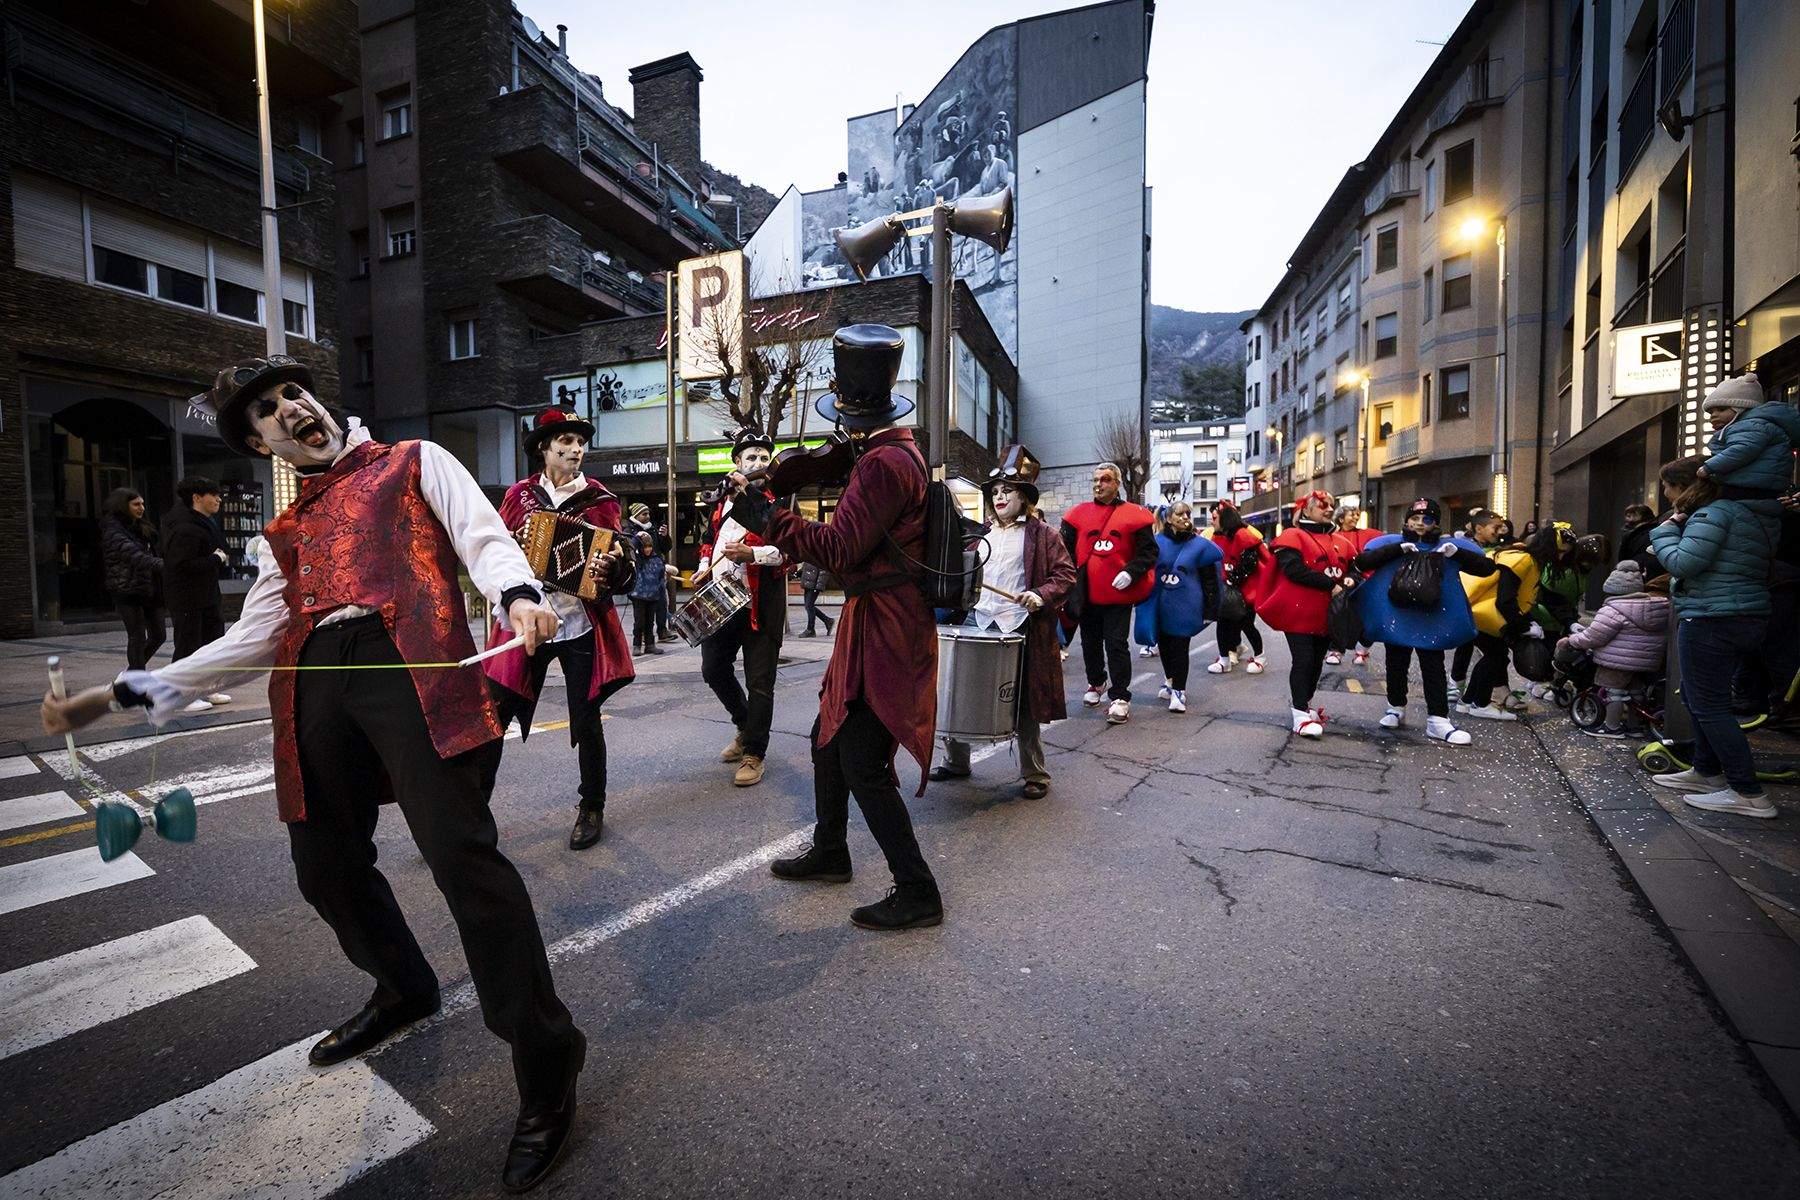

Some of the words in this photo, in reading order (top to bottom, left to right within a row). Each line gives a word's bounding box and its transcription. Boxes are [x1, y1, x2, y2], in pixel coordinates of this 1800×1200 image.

[691, 266, 729, 328] P
[612, 463, 628, 475] BAR
[630, 460, 660, 474] L'HÒSTIA
